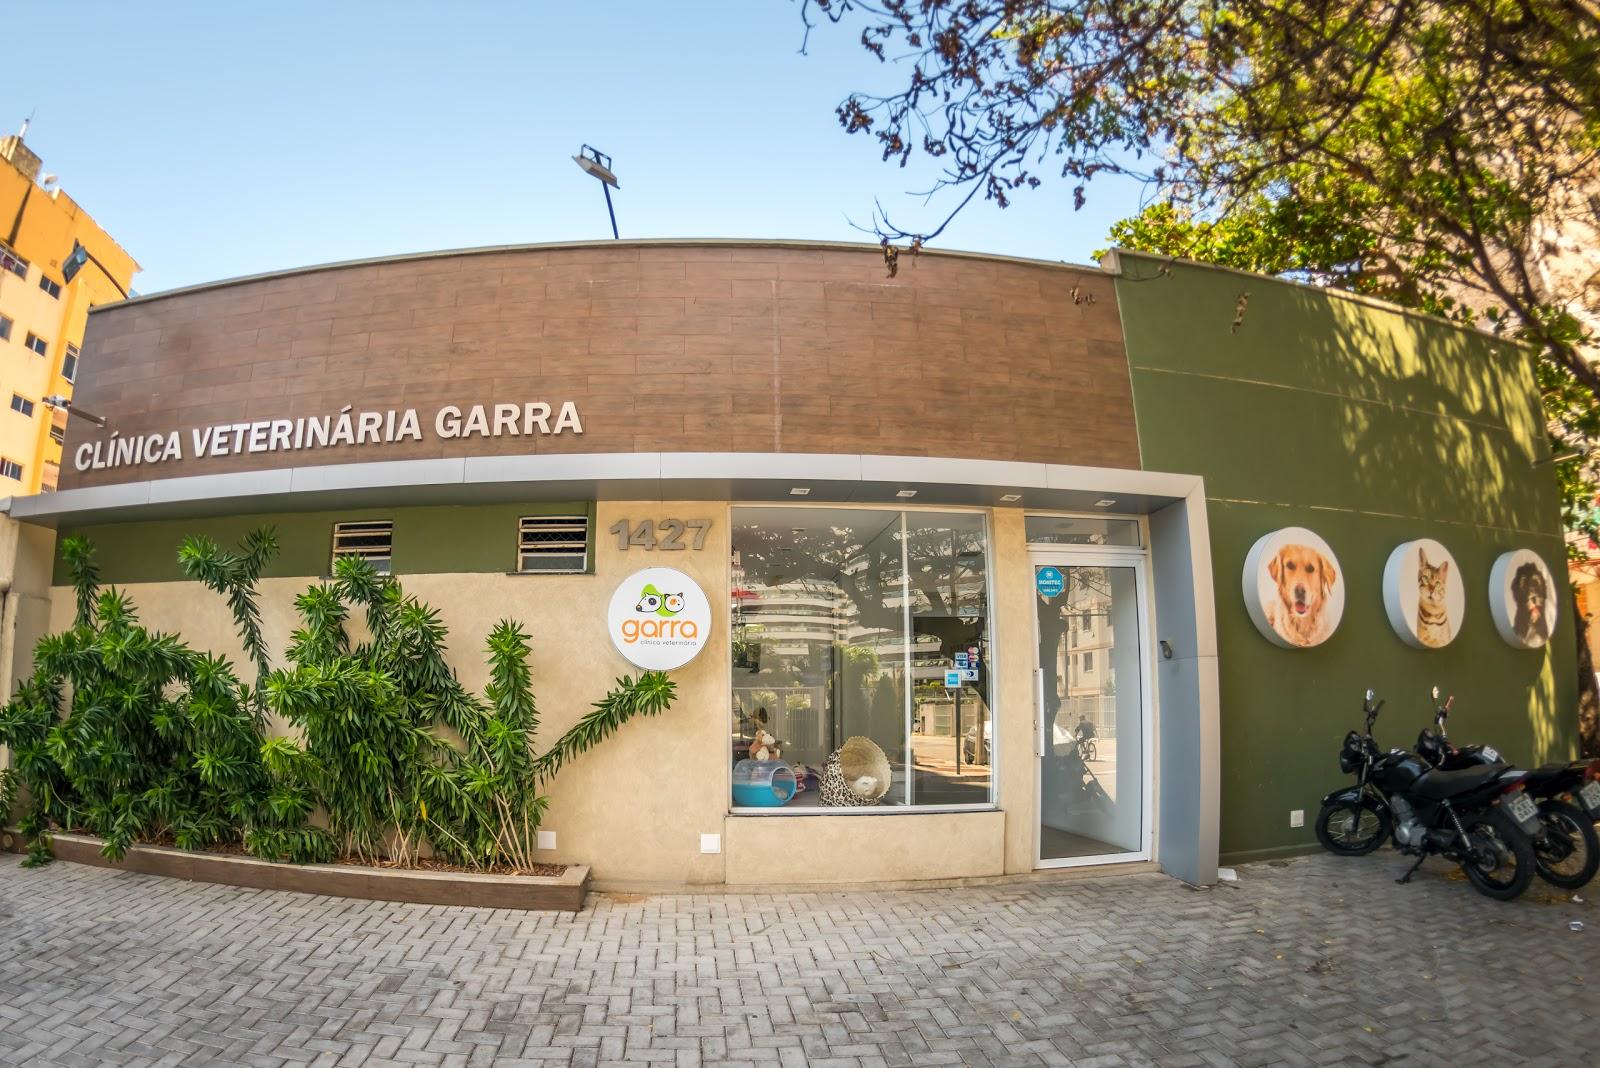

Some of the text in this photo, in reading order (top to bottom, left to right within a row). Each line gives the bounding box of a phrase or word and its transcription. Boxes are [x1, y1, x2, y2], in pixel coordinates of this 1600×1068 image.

[75, 401, 584, 471] CLÍNICA VETERINÁRIA GARRA
[609, 518, 712, 551] 1427
[621, 619, 698, 644] garra
